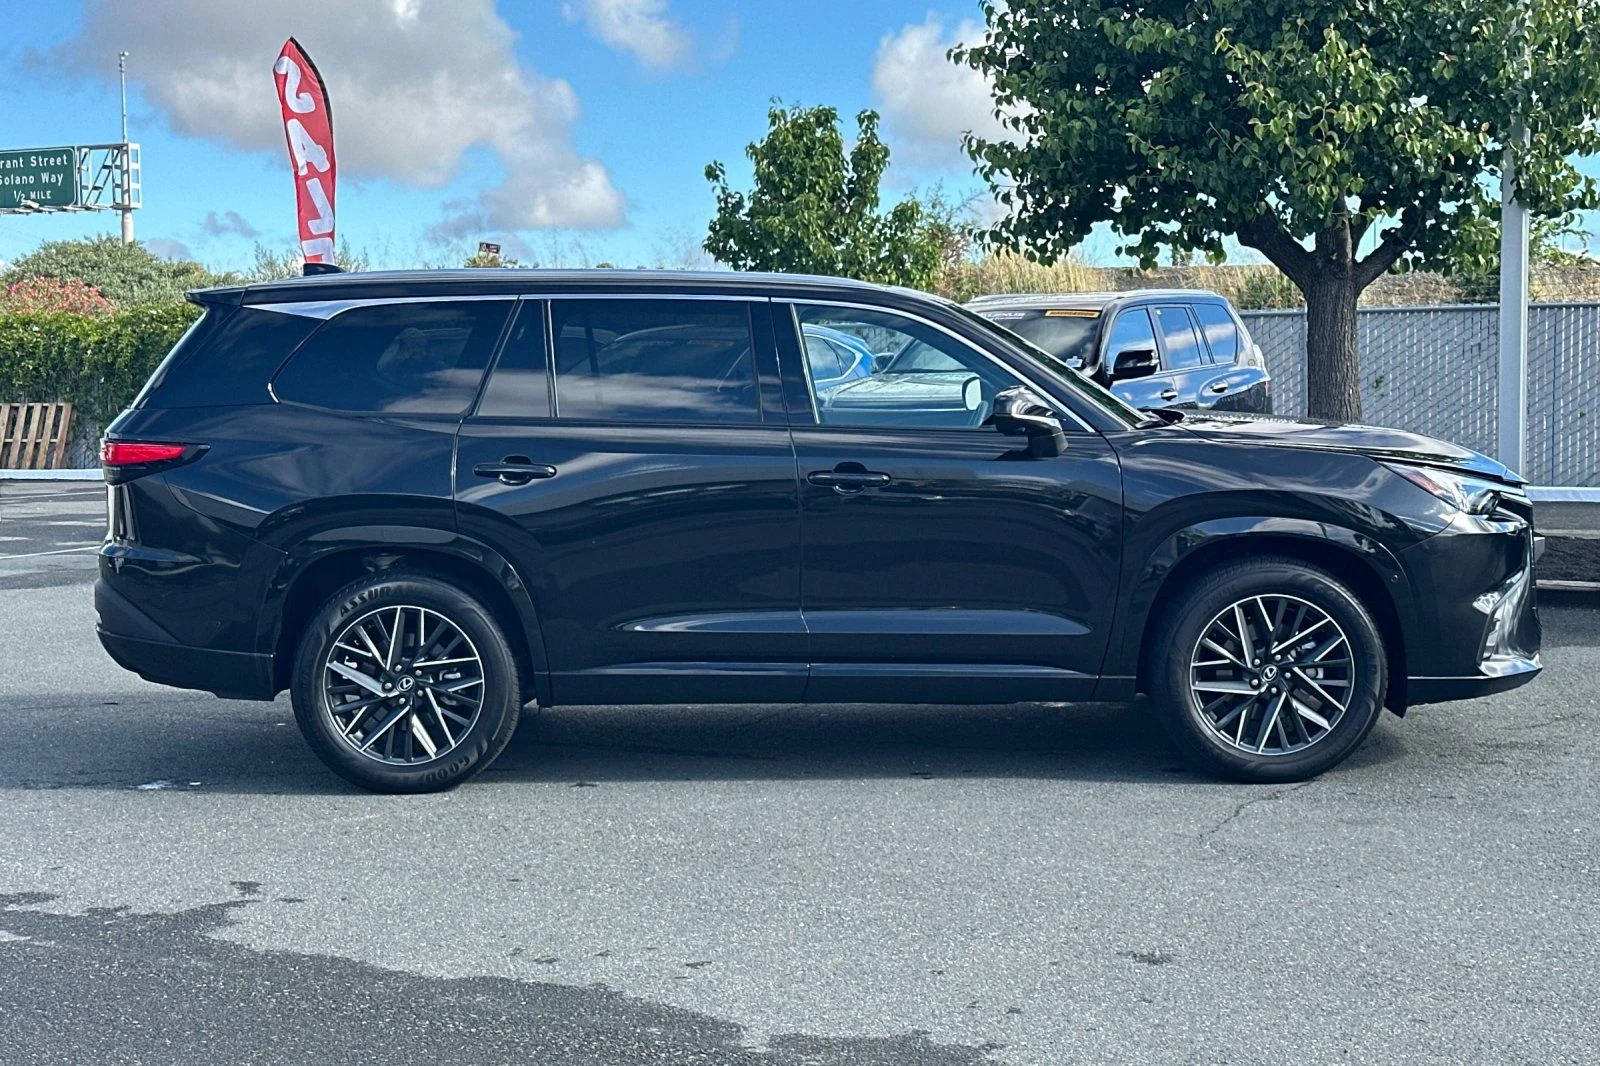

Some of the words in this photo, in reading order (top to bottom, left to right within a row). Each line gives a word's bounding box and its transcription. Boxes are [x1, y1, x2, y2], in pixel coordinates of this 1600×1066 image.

[0, 156, 24, 169] rant
[30, 154, 68, 167] Street
[41, 171, 64, 187] Way
[30, 190, 52, 200] MILE
